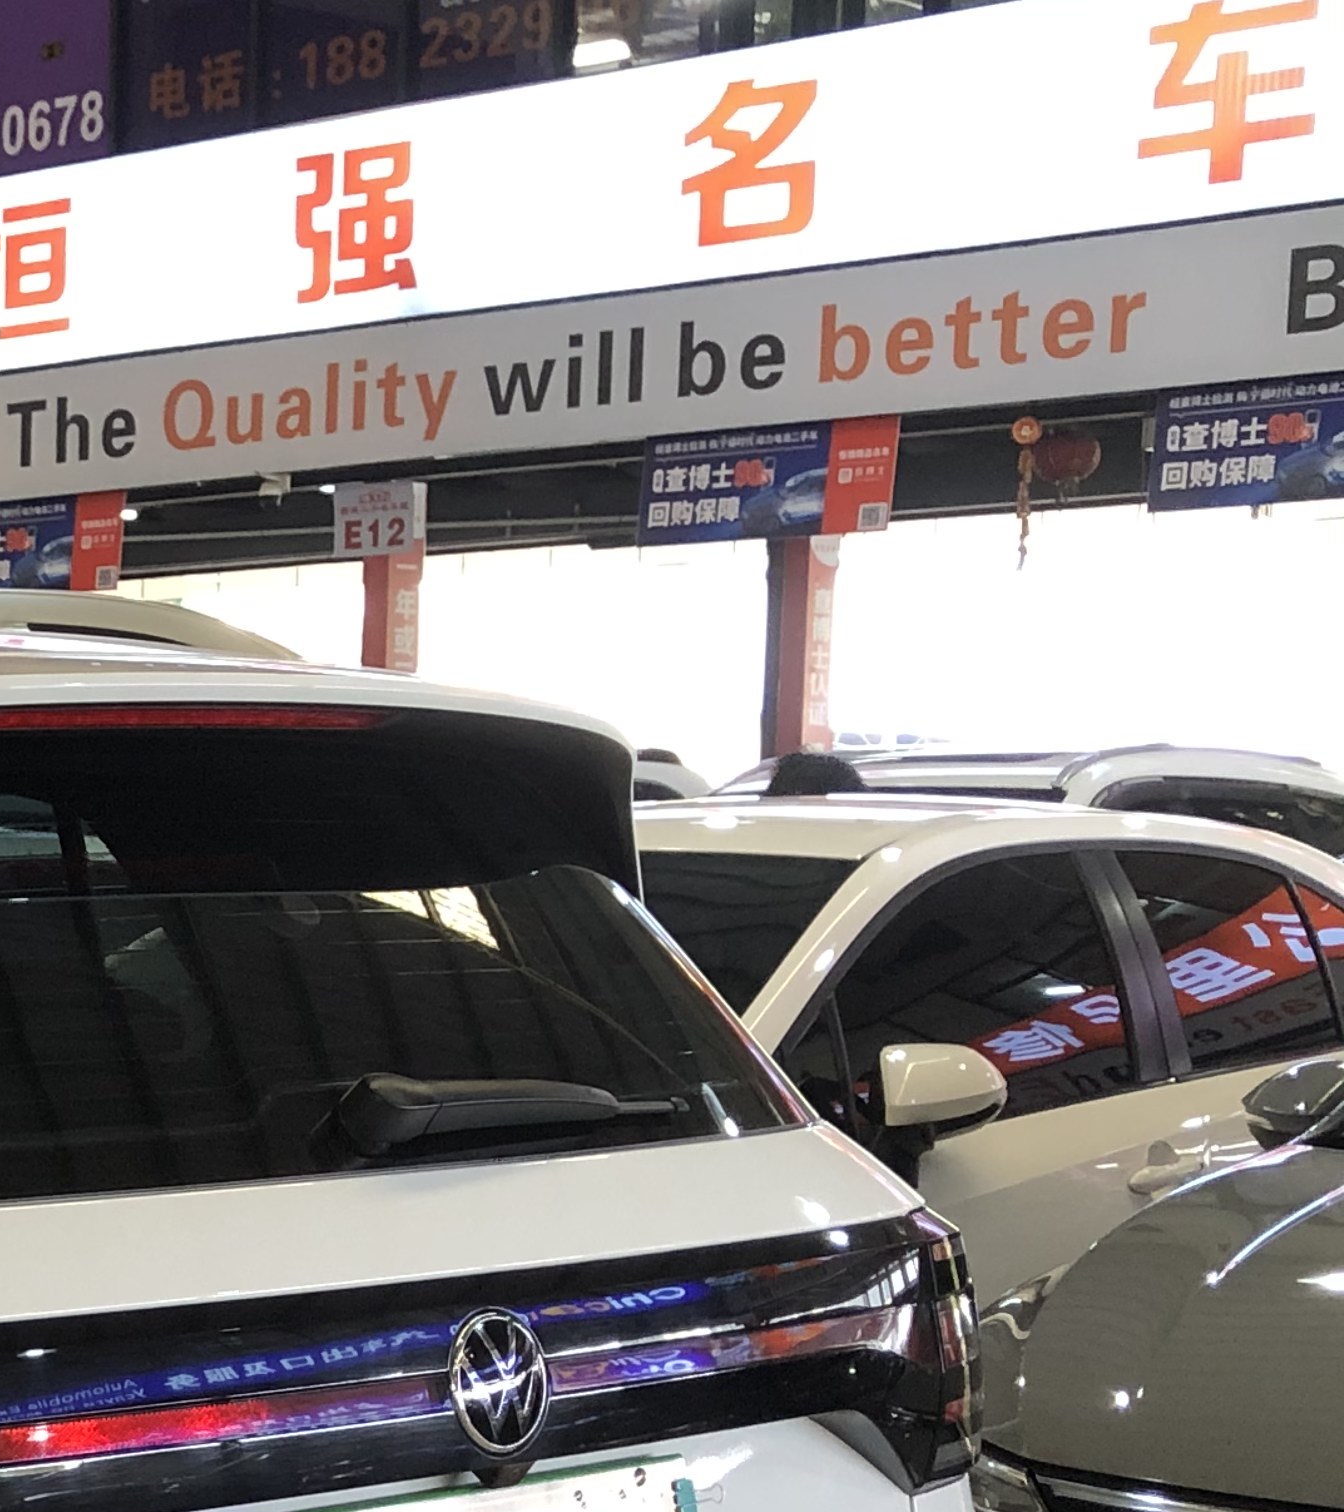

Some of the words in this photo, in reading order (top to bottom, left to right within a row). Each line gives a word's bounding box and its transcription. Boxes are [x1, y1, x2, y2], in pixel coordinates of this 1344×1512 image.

[298, 30, 387, 89] 188
[419, 0, 553, 69] 2329
[2, 90, 105, 156] 0678
[6, 396, 137, 468] The
[163, 357, 458, 451] Quality
[484, 326, 645, 416] will
[677, 321, 787, 399] be
[818, 290, 1148, 383] better
[1160, 453, 1277, 491] 回购保障
[344, 516, 406, 550] E12
[647, 496, 741, 529] 回购保障
